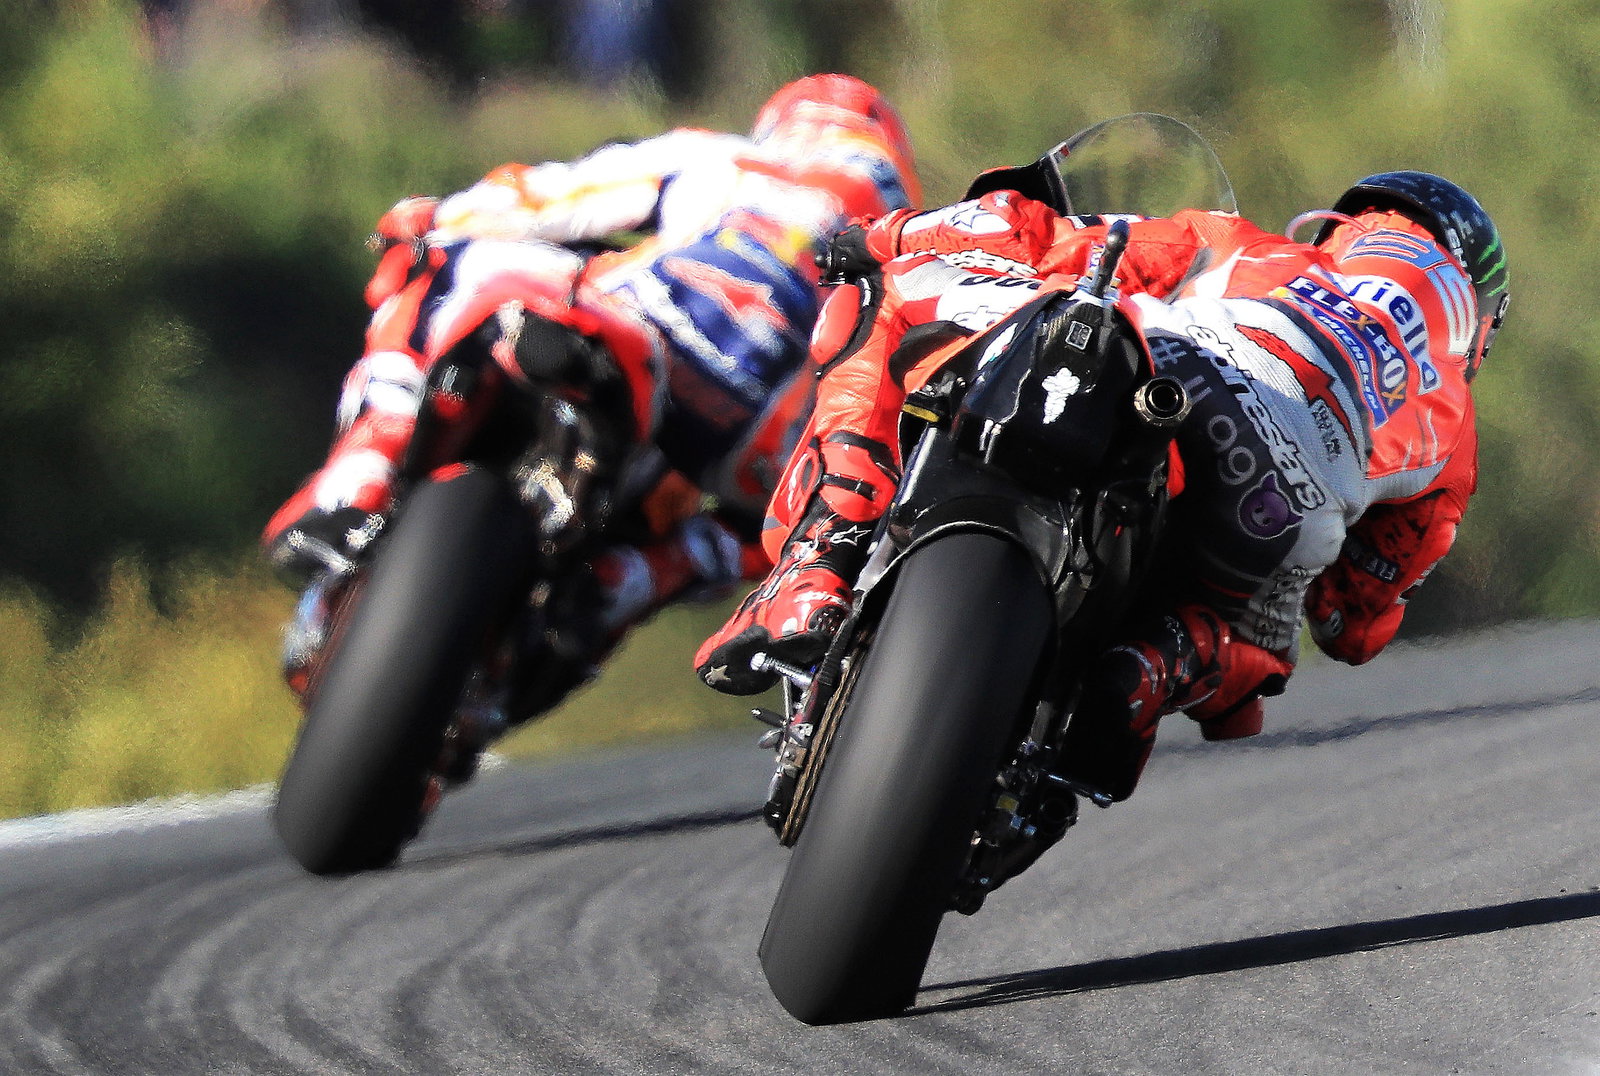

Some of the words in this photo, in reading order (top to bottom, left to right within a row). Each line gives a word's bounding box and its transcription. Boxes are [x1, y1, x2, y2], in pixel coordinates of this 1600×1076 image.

[1287, 276, 1407, 406] FLEX-BOX
[1315, 313, 1380, 410] MICHELIN
[1186, 323, 1327, 511] alpinestars
